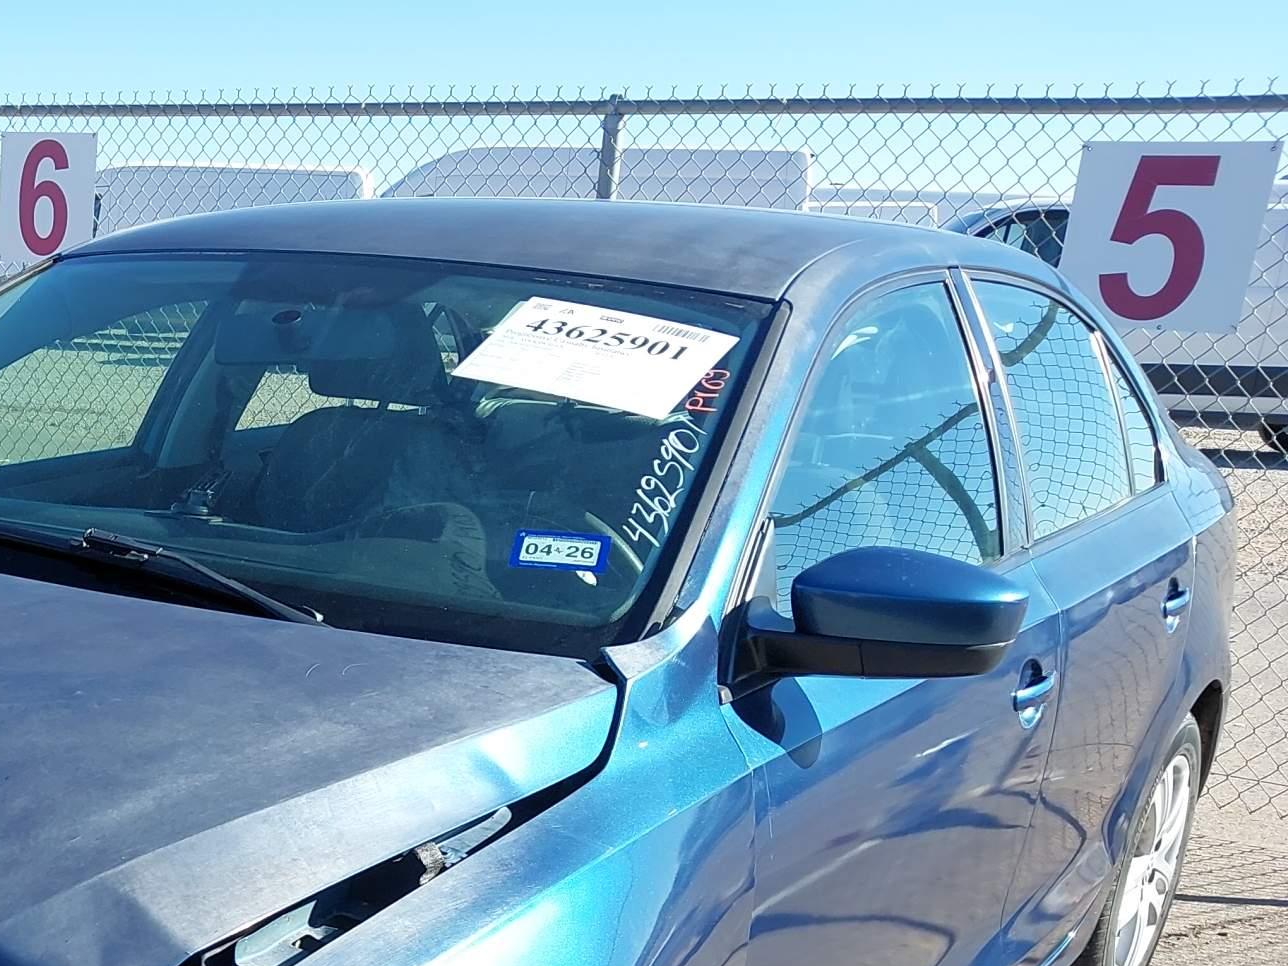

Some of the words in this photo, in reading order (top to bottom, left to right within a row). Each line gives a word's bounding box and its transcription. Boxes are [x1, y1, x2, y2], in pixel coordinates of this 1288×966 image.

[18, 138, 70, 257] 6
[1098, 154, 1222, 321] 5
[525, 317, 689, 361] 43625901
[622, 414, 708, 548] 43625901
[525, 542, 553, 556] 04
[564, 545, 594, 560] 26
